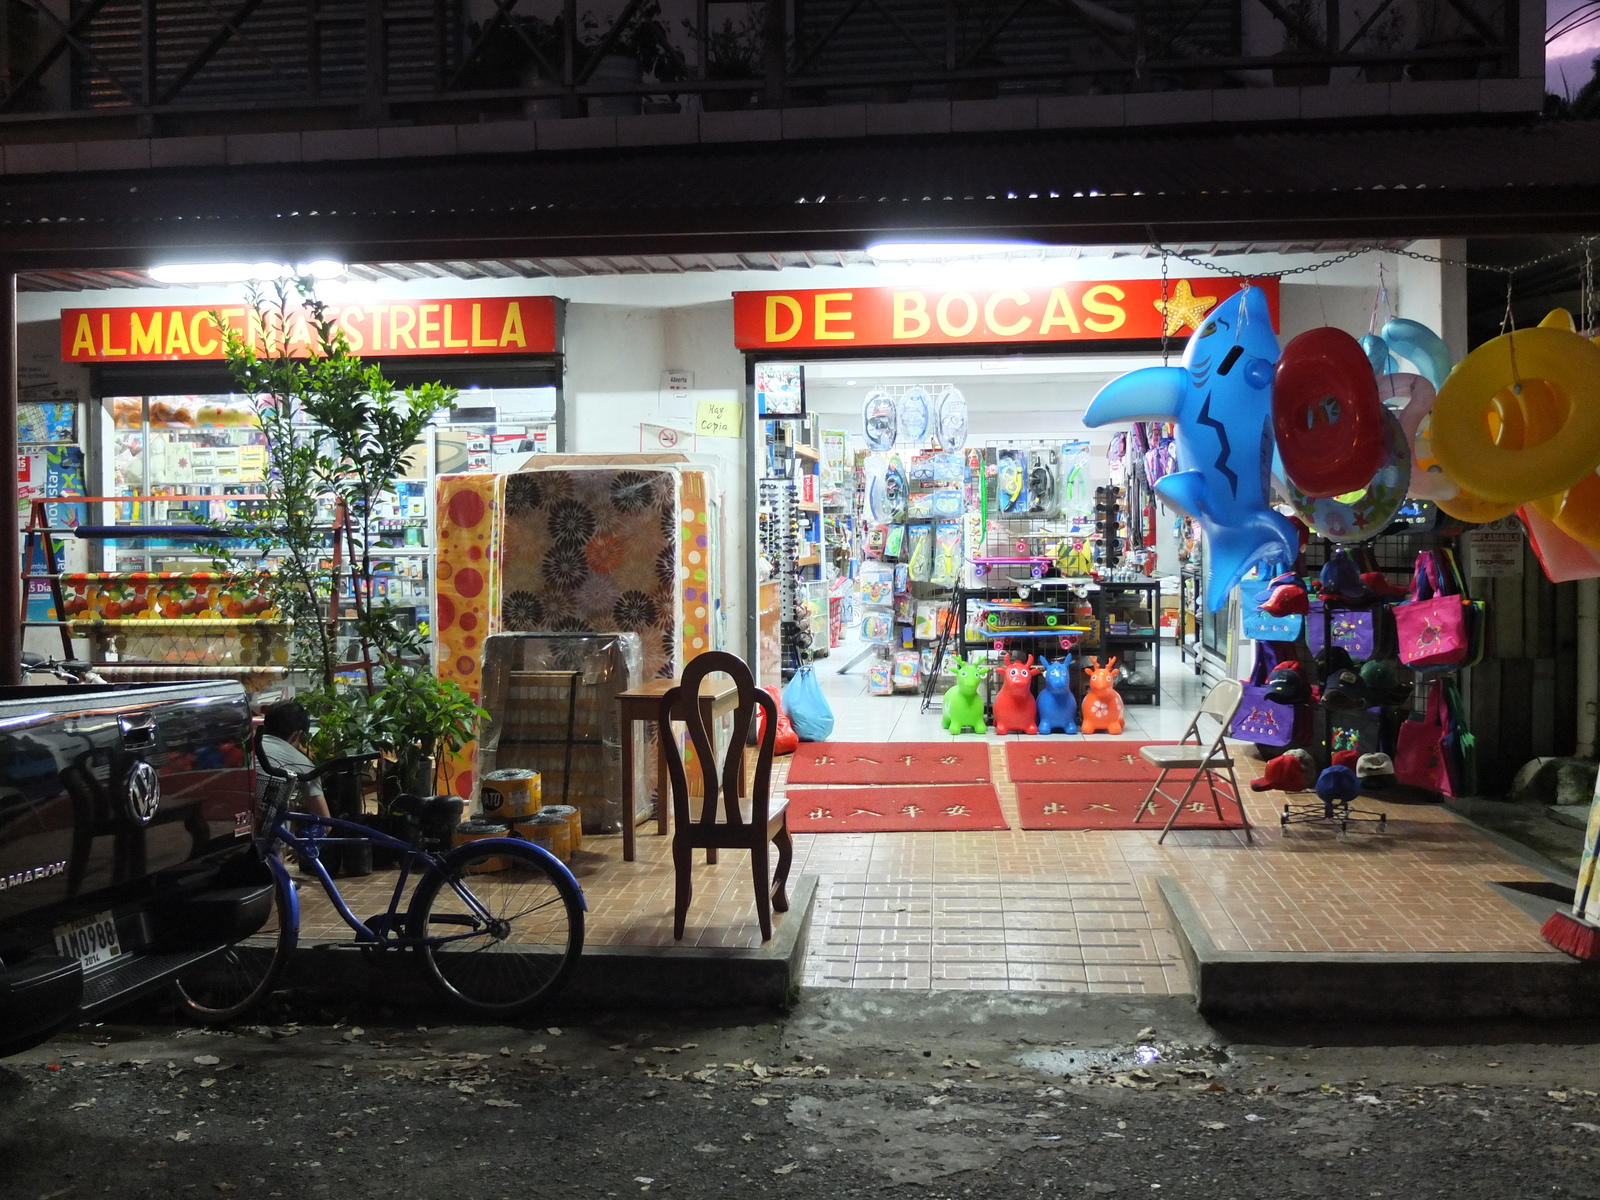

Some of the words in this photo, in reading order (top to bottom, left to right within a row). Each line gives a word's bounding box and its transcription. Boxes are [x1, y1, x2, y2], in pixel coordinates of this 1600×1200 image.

[765, 292, 855, 342] DE
[893, 284, 1126, 339] BOCAS
[71, 308, 277, 356] ALMACEN
[318, 301, 528, 353] ESTRELLA
[709, 404, 724, 419] Hay
[701, 420, 728, 434] Copia
[48, 469, 59, 527] movstar
[37, 582, 52, 593] Día
[1033, 753, 1142, 766] 出入平
[806, 803, 973, 821] 出入平安
[0, 861, 67, 891] AMAROK
